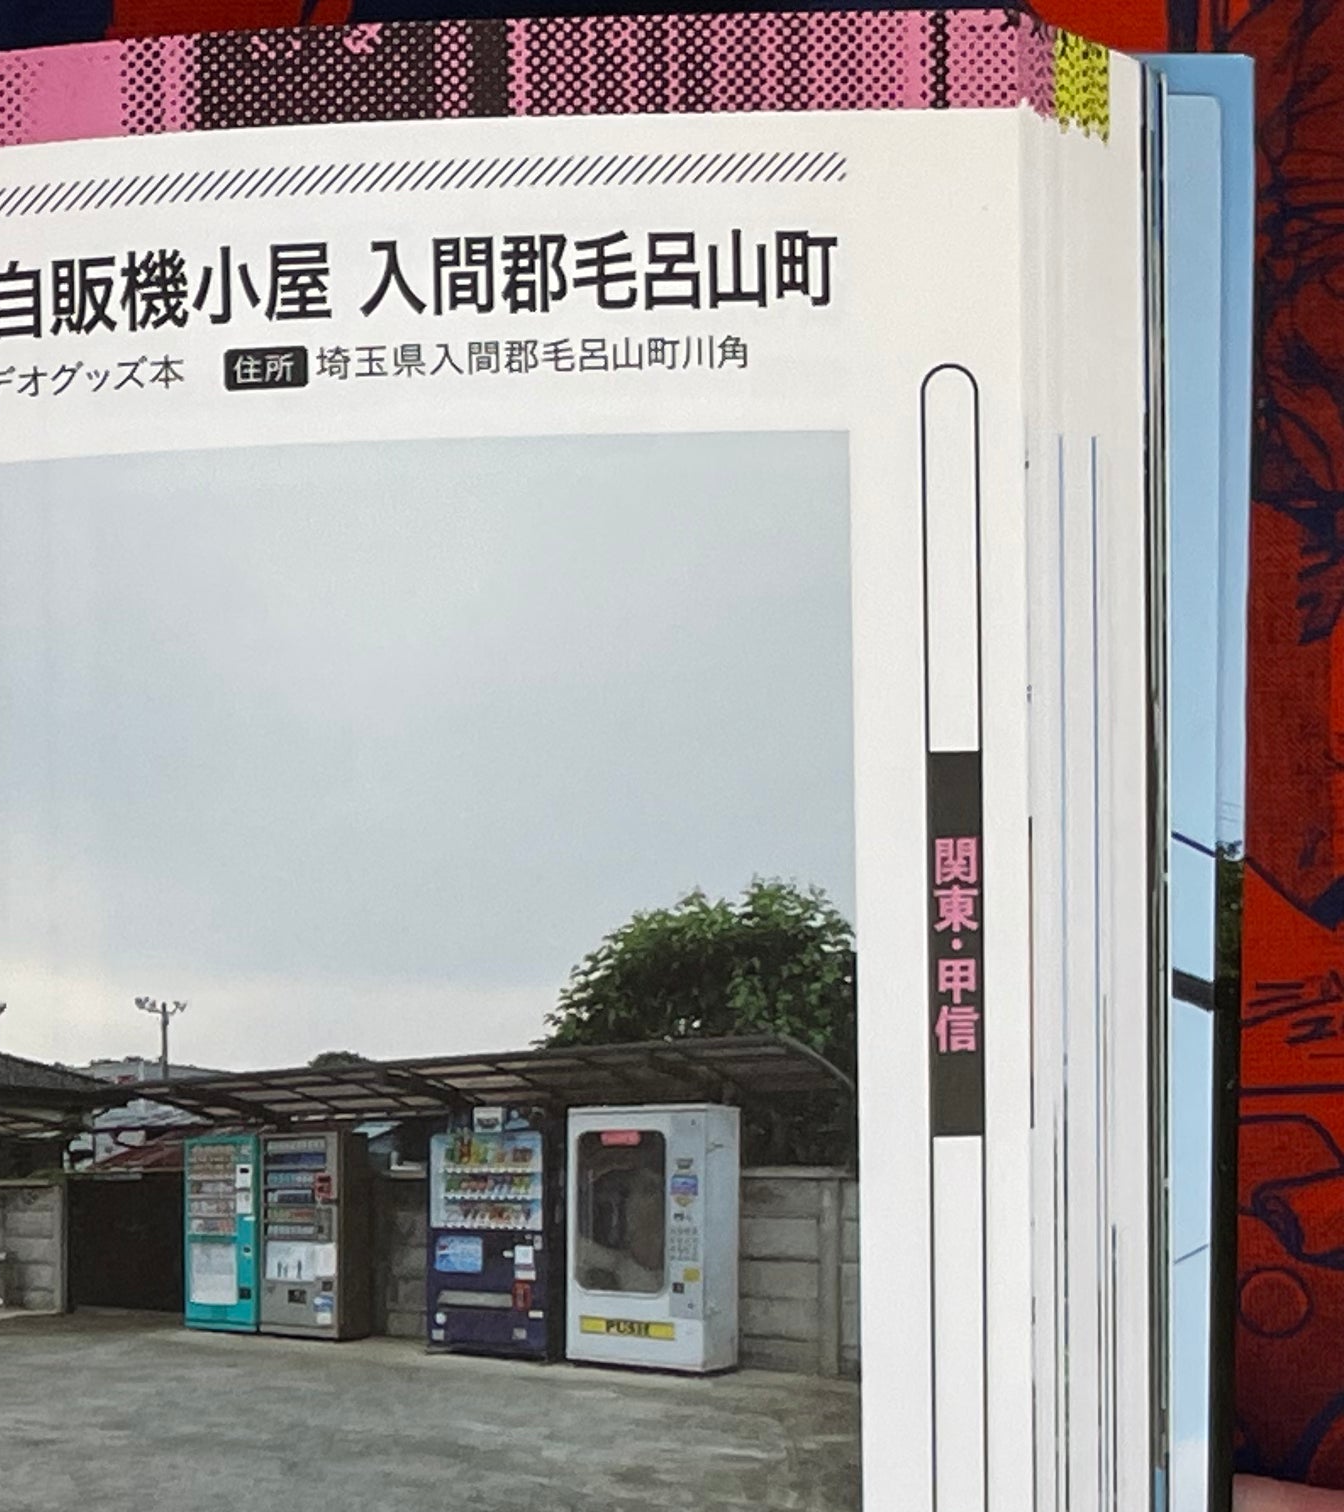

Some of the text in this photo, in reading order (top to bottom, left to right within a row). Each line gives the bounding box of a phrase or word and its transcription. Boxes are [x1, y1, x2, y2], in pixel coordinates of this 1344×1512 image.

[360, 228, 839, 317] 入間郡毛呂山町
[231, 352, 296, 384] 住所
[315, 333, 748, 380] 埼玉県入間郡毛呂山町川角
[933, 837, 980, 1053] 関東・甲信
[605, 1320, 650, 1338] PUSH
